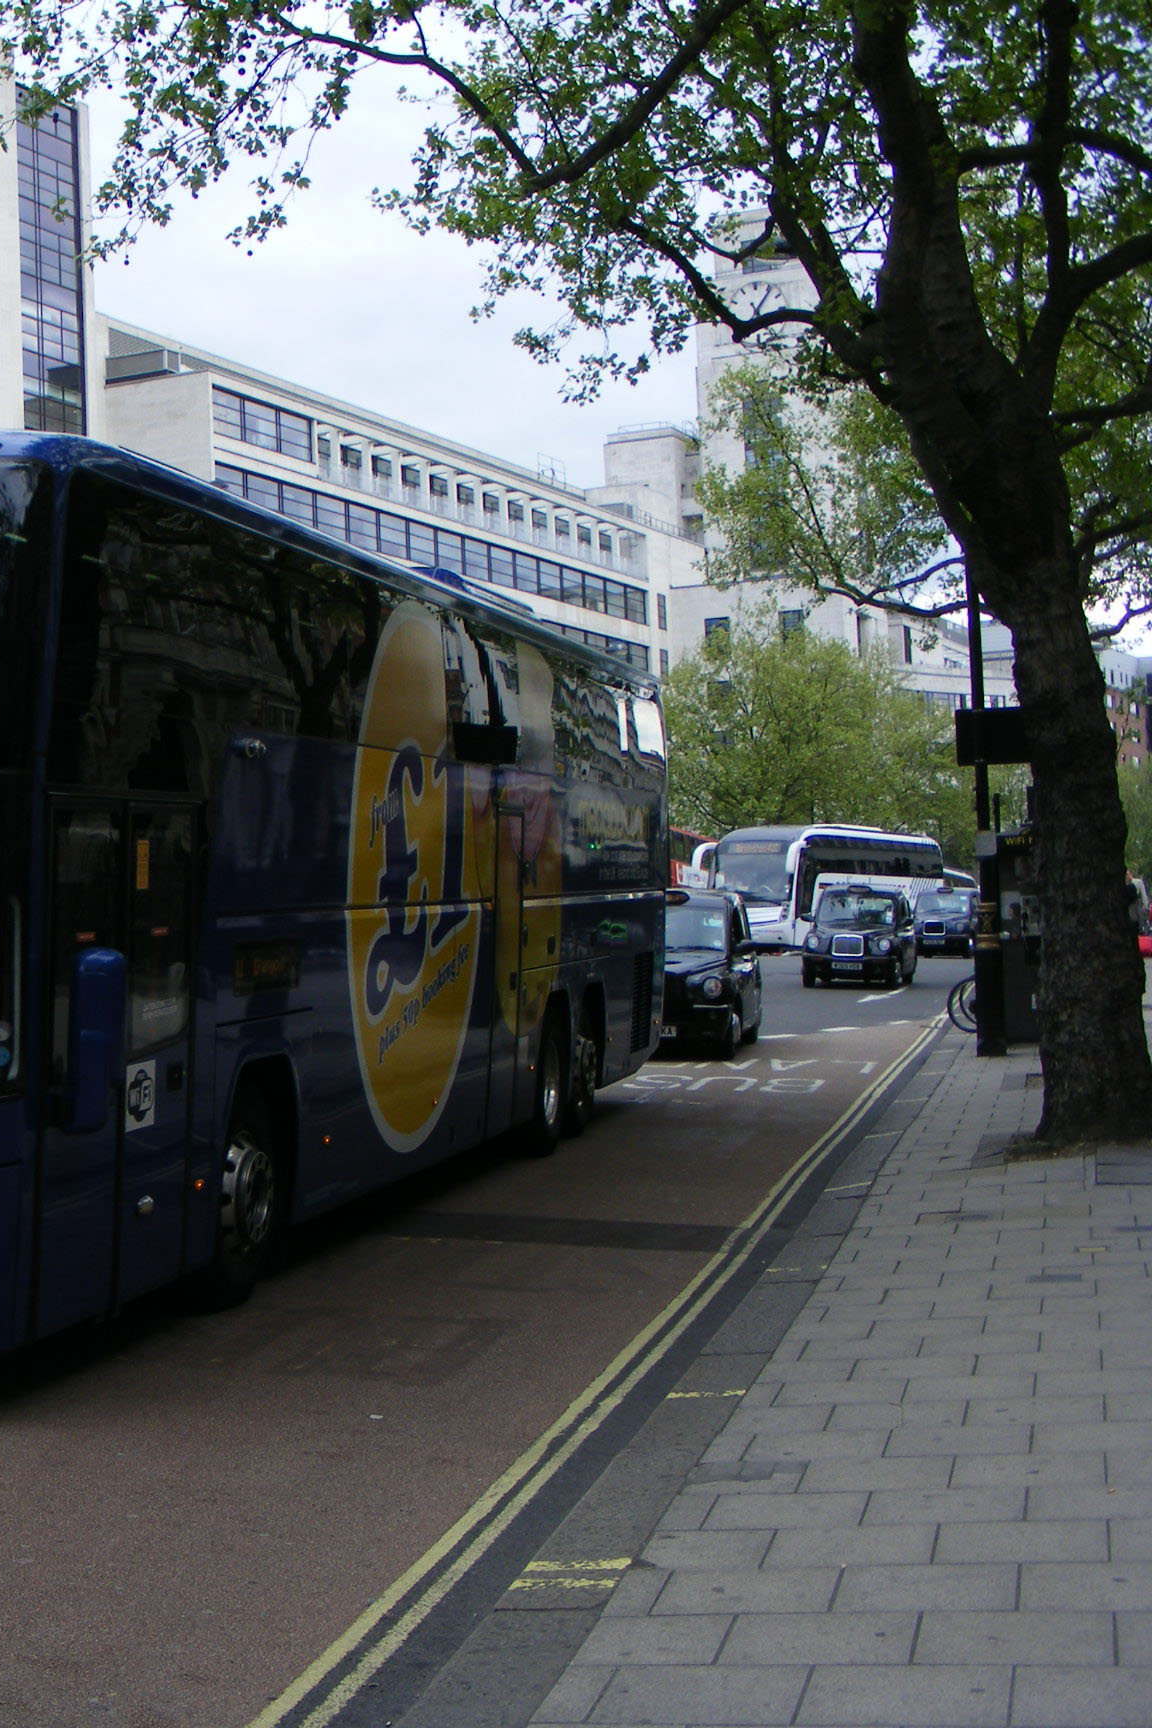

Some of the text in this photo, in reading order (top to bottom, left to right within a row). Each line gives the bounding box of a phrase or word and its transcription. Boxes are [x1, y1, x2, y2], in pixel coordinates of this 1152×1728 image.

[369, 787, 399, 848] from
[365, 742, 470, 1016] £1
[622, 1074, 826, 1094] BUS
